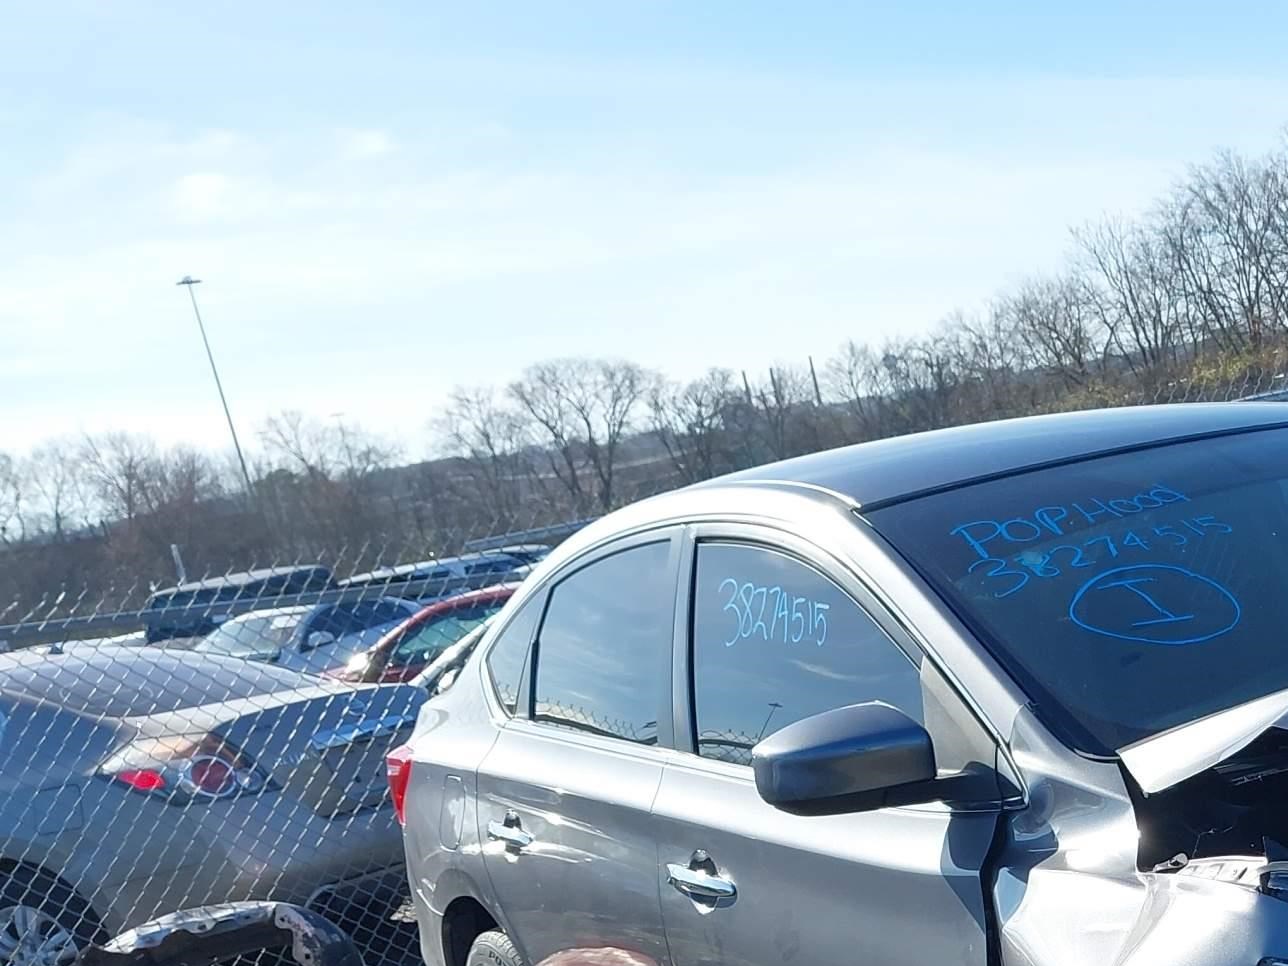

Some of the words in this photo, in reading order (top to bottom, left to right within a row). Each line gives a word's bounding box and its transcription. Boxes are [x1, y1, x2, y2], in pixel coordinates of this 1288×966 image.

[950, 505, 1068, 560] POP
[968, 515, 1233, 599] 38274515
[718, 578, 830, 647] 38274515
